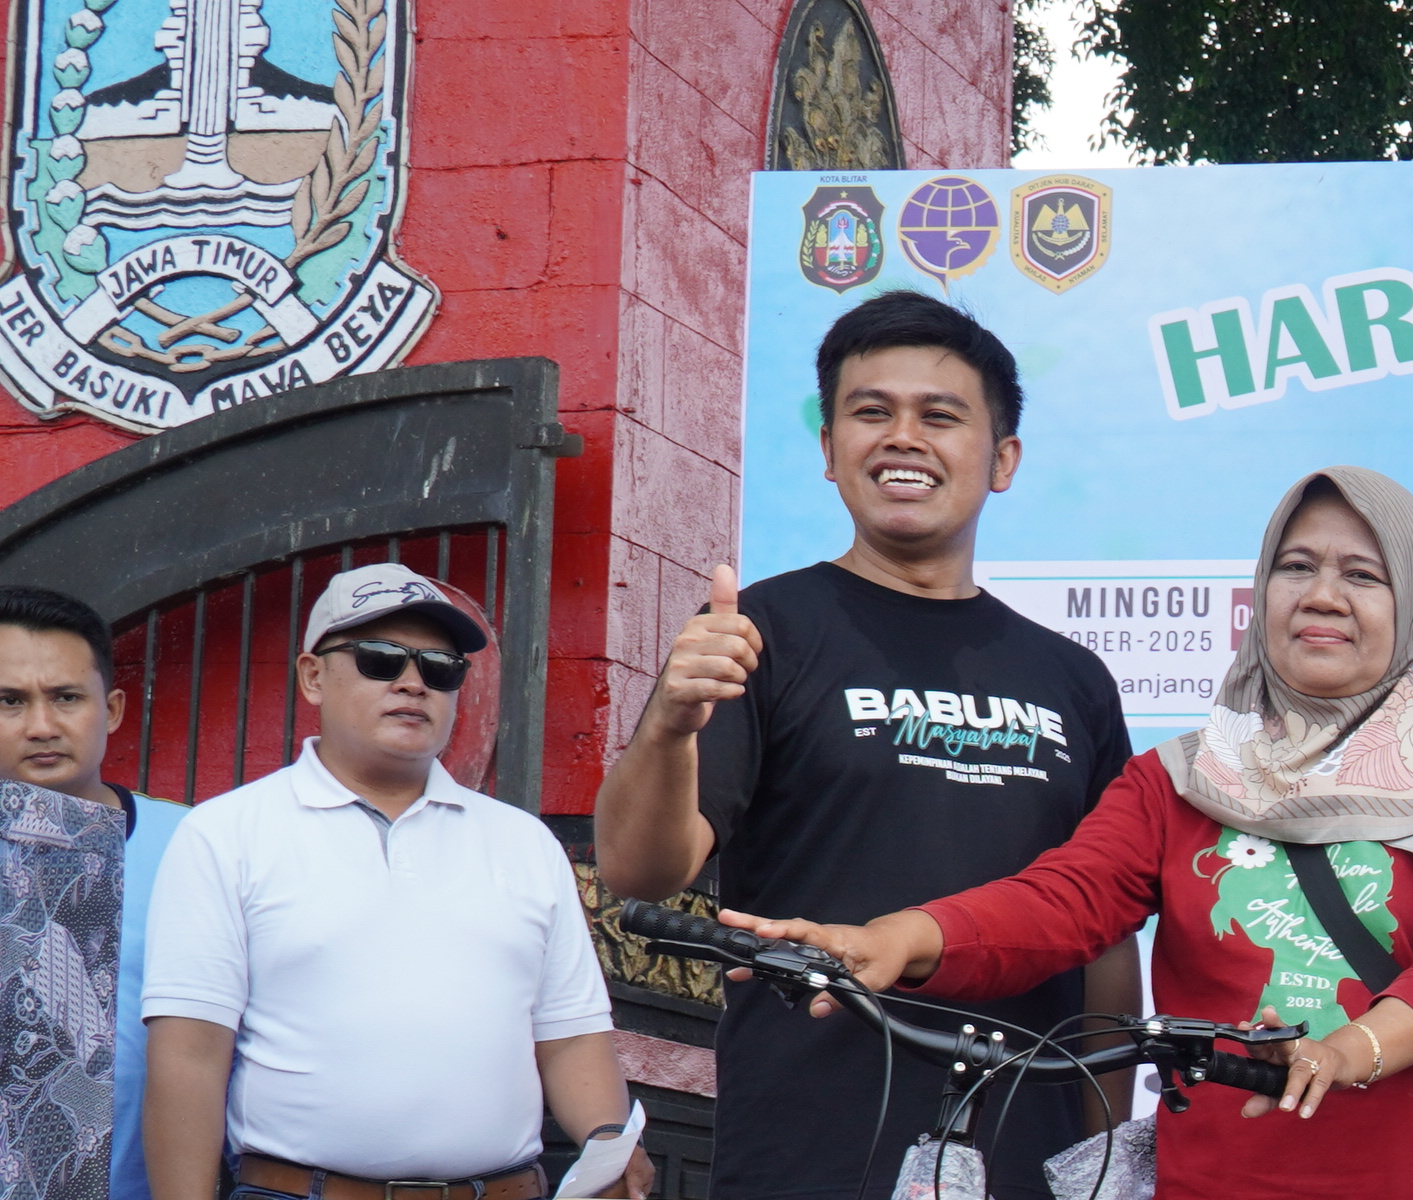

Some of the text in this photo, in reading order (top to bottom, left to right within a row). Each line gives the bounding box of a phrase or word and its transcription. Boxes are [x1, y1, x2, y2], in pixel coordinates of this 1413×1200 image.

[841, 175, 868, 183] BLITAR
[1028, 180, 1053, 191] DITJEN
[110, 240, 281, 299] JAWA TIMUR
[2, 290, 46, 347] JER
[53, 350, 171, 420] BASUKI
[324, 280, 405, 364] BEYA
[1067, 586, 1211, 619] MINGGU
[1058, 630, 1213, 653] OBER-2025
[1120, 673, 1214, 699] anjang
[844, 688, 1067, 747] BABUNE
[855, 727, 877, 737] EST
[885, 704, 1043, 763] Masyarakat
[1279, 971, 1334, 991] ESTD.
[1286, 996, 1323, 1009] 2021
